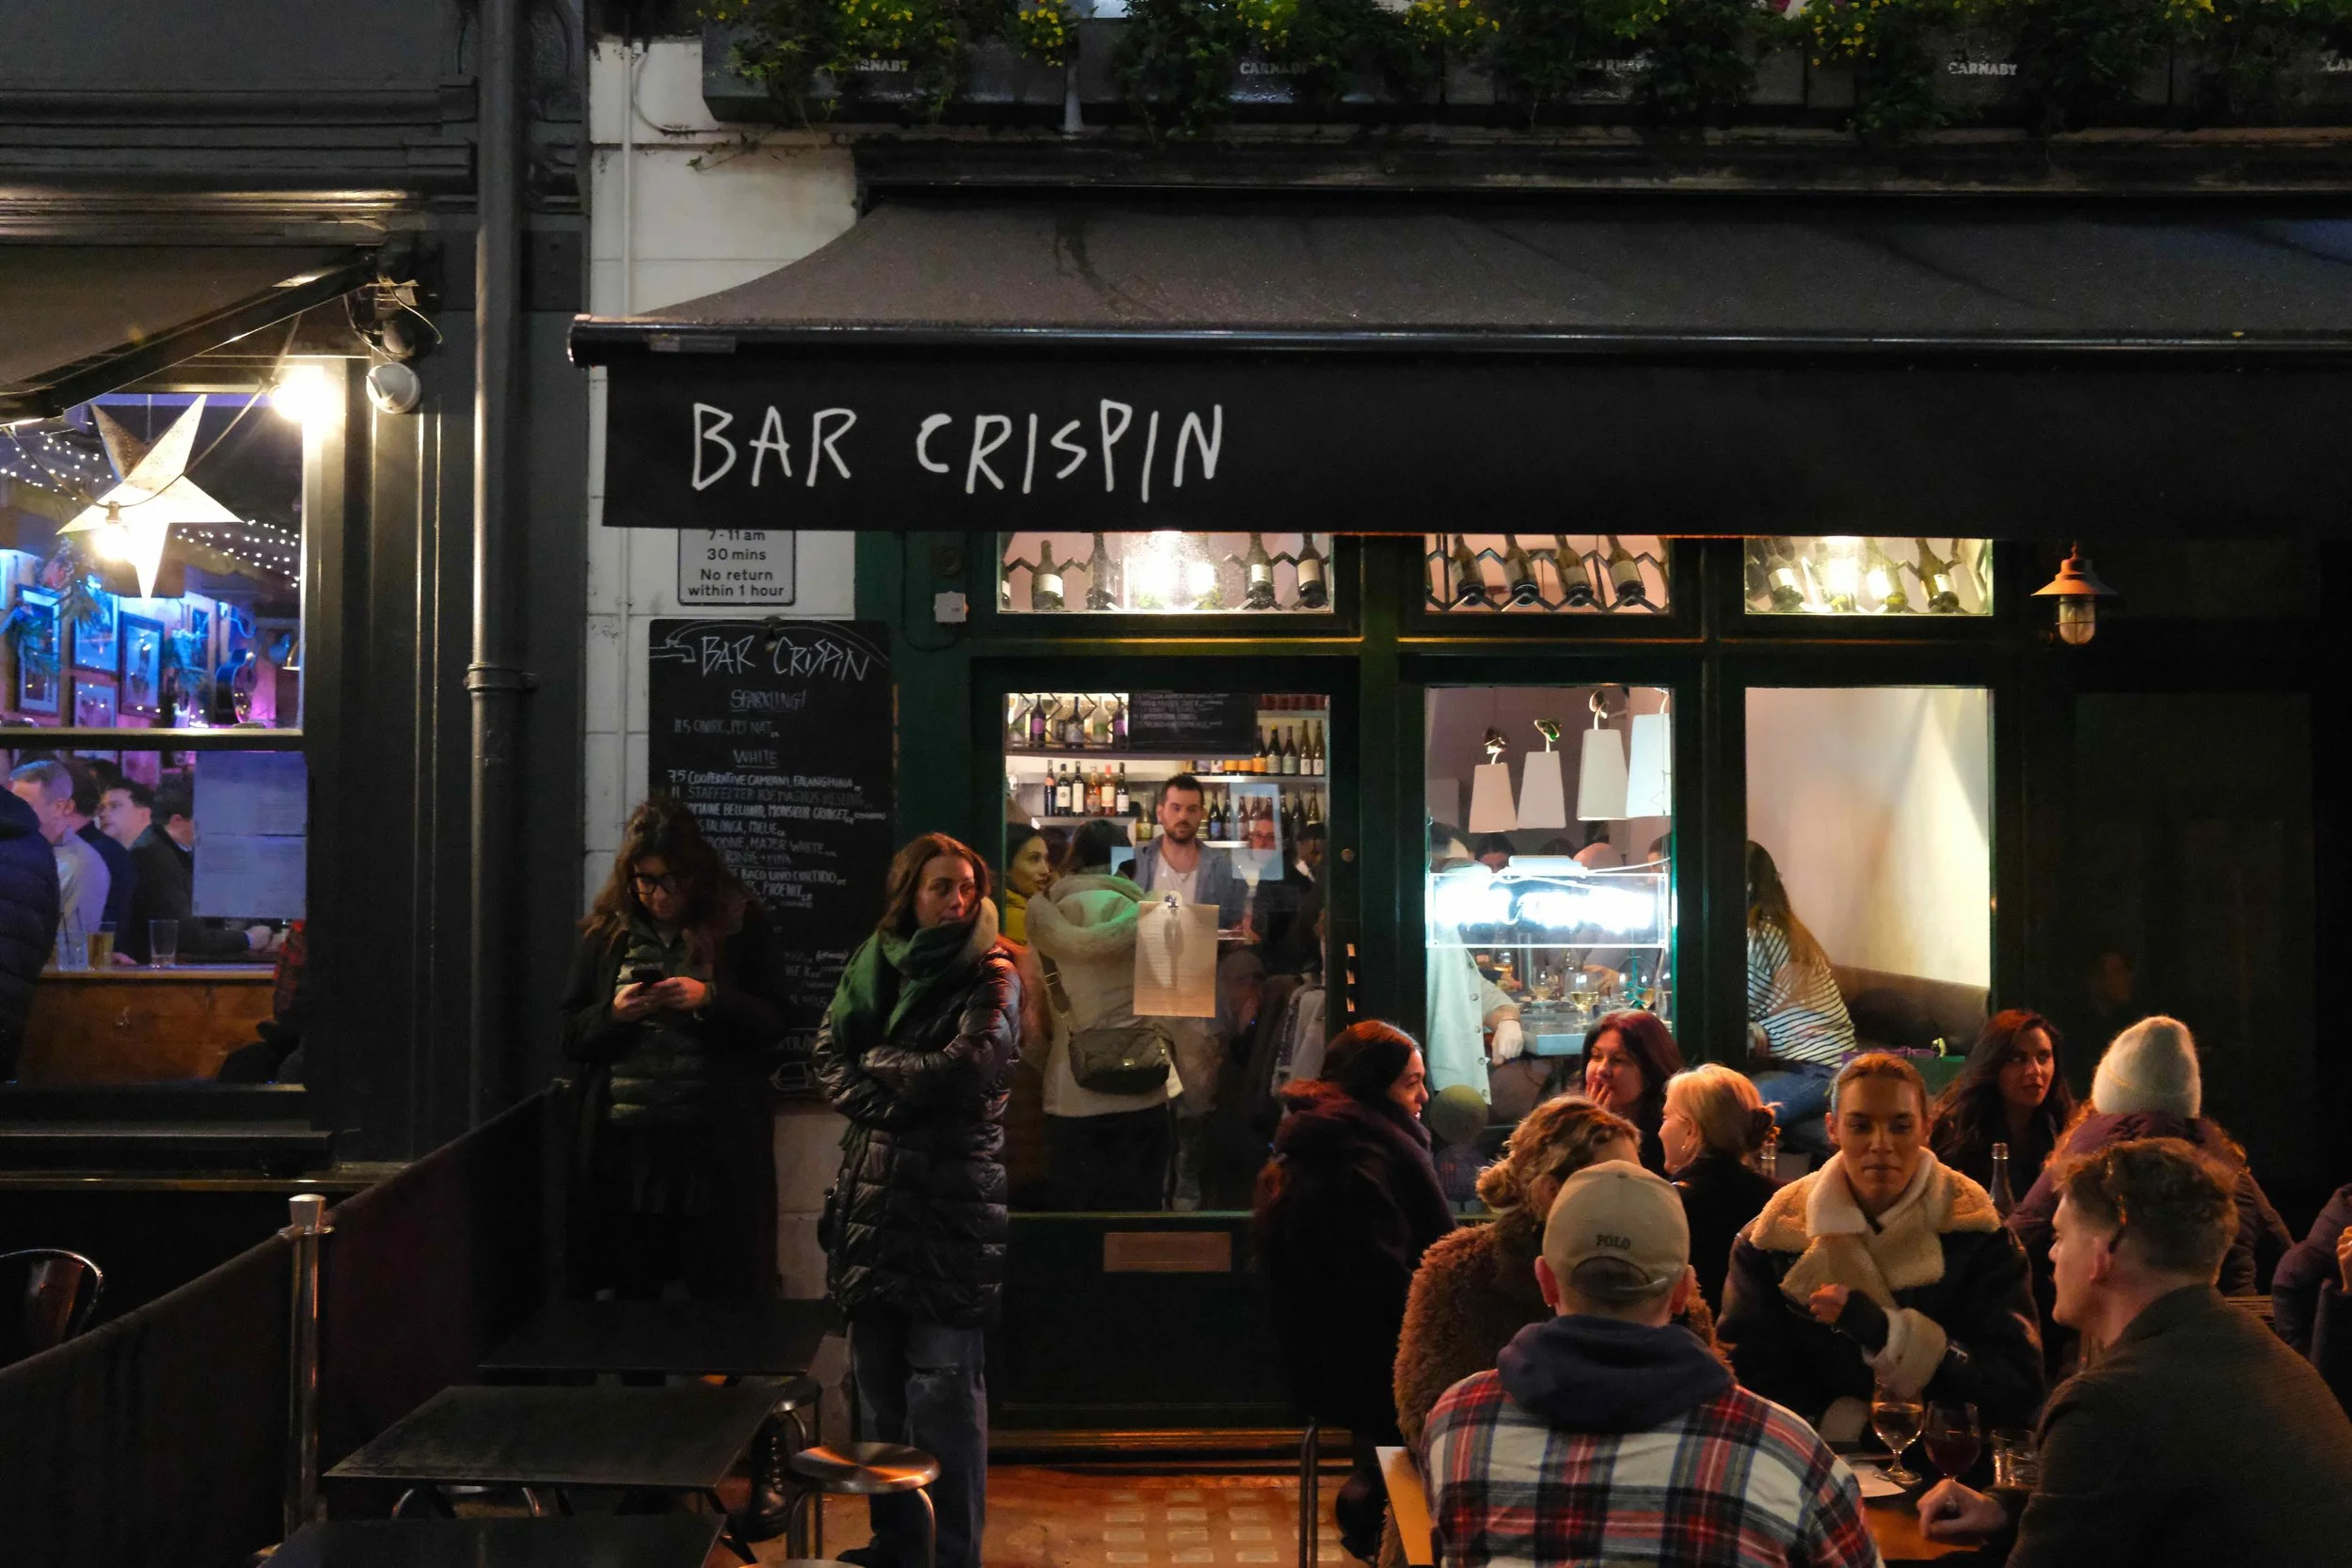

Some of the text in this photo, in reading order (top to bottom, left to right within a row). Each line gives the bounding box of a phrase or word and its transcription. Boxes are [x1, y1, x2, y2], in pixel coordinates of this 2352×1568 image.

[1947, 61, 2018, 75] CARNABY
[691, 399, 1222, 503] BAR CRISPIN
[744, 531, 766, 542] am
[707, 548, 767, 561] 30 mins
[700, 569, 773, 581] No return
[688, 585, 785, 596] within 1 hour
[701, 635, 756, 677] BAR
[733, 750, 779, 766] WHITE
[1596, 1234, 1631, 1250] POLO
